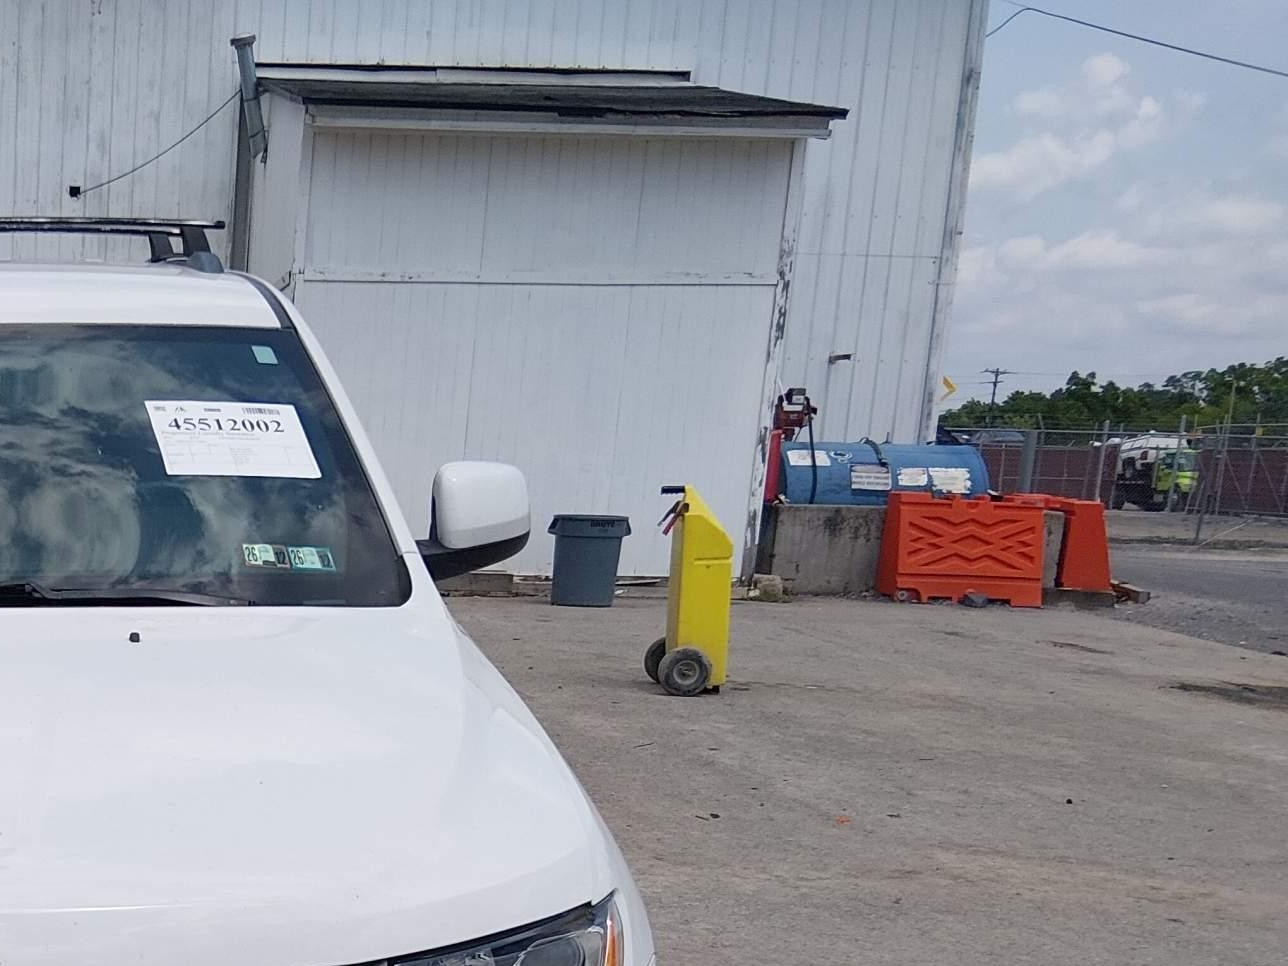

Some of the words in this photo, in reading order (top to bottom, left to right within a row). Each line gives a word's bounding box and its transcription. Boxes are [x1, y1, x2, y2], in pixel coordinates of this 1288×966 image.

[168, 417, 285, 433] 45512002
[245, 546, 258, 562] 26
[291, 550, 305, 565] 26
